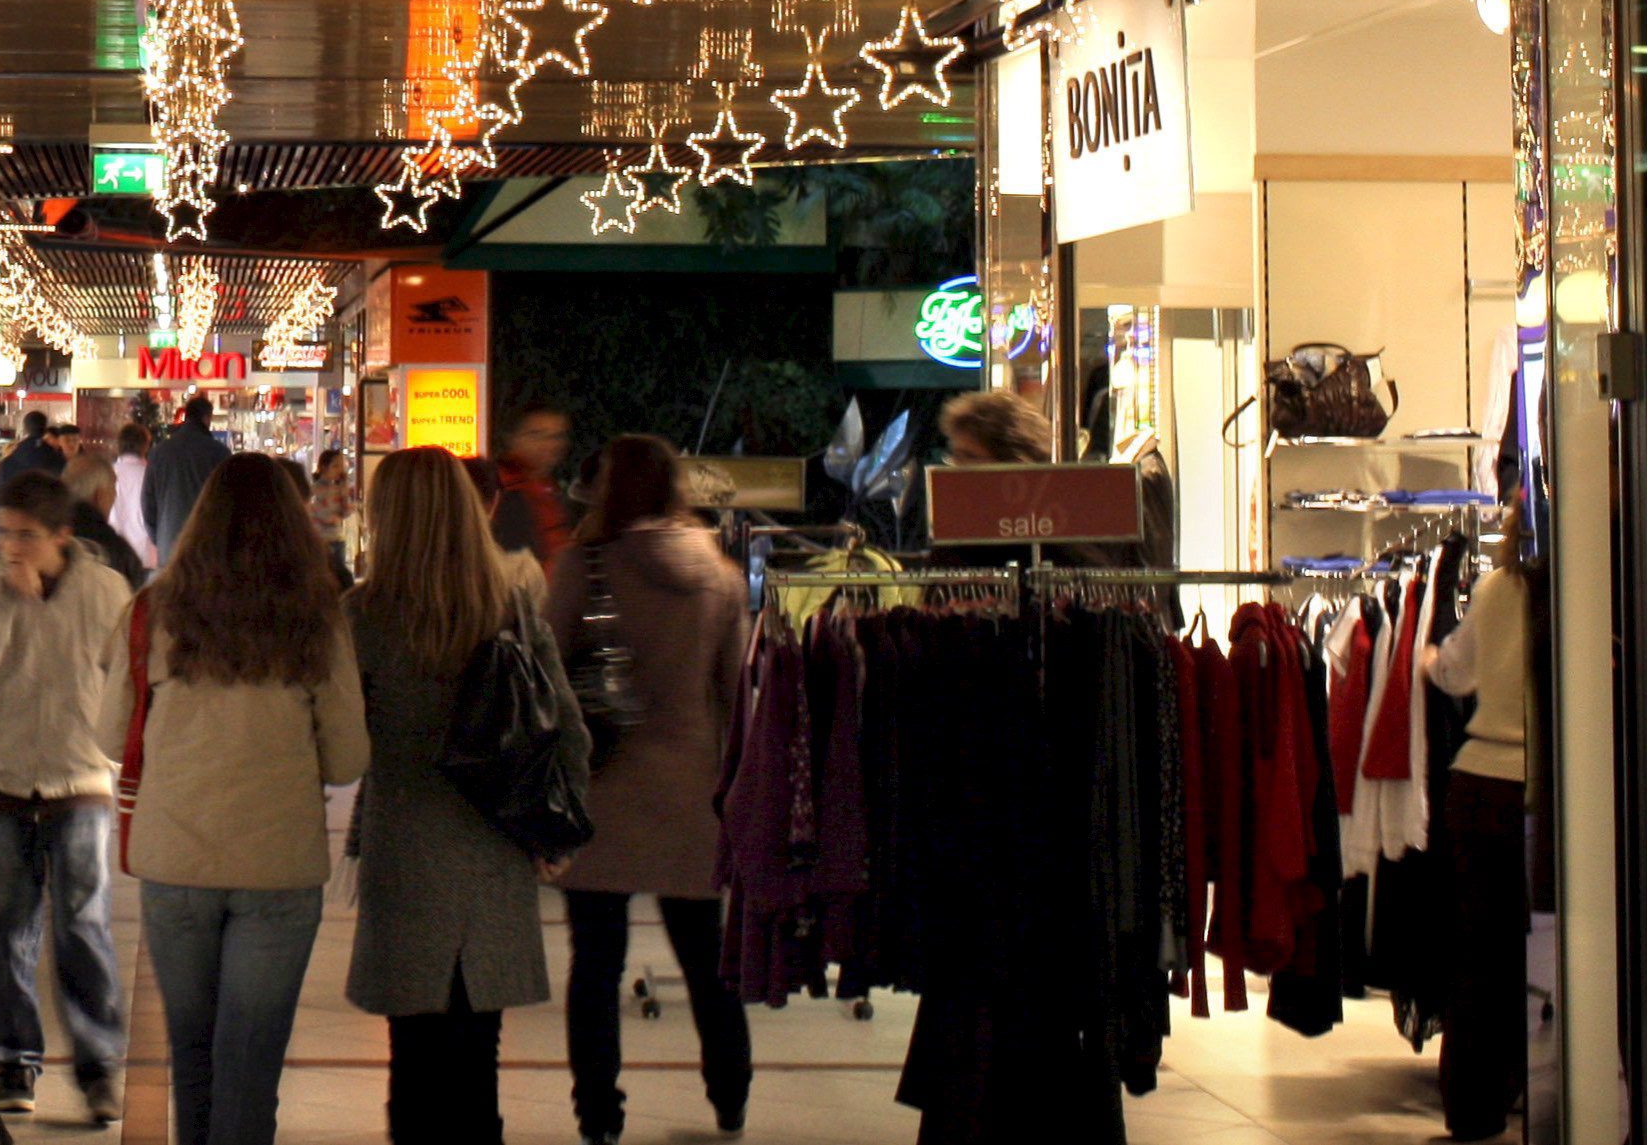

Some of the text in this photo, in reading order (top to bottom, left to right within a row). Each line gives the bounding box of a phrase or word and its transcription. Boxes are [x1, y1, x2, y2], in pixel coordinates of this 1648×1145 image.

[1067, 30, 1162, 172] BONITA
[137, 343, 246, 380] Milan
[442, 388, 470, 398] COOL
[998, 513, 1053, 537] sale
